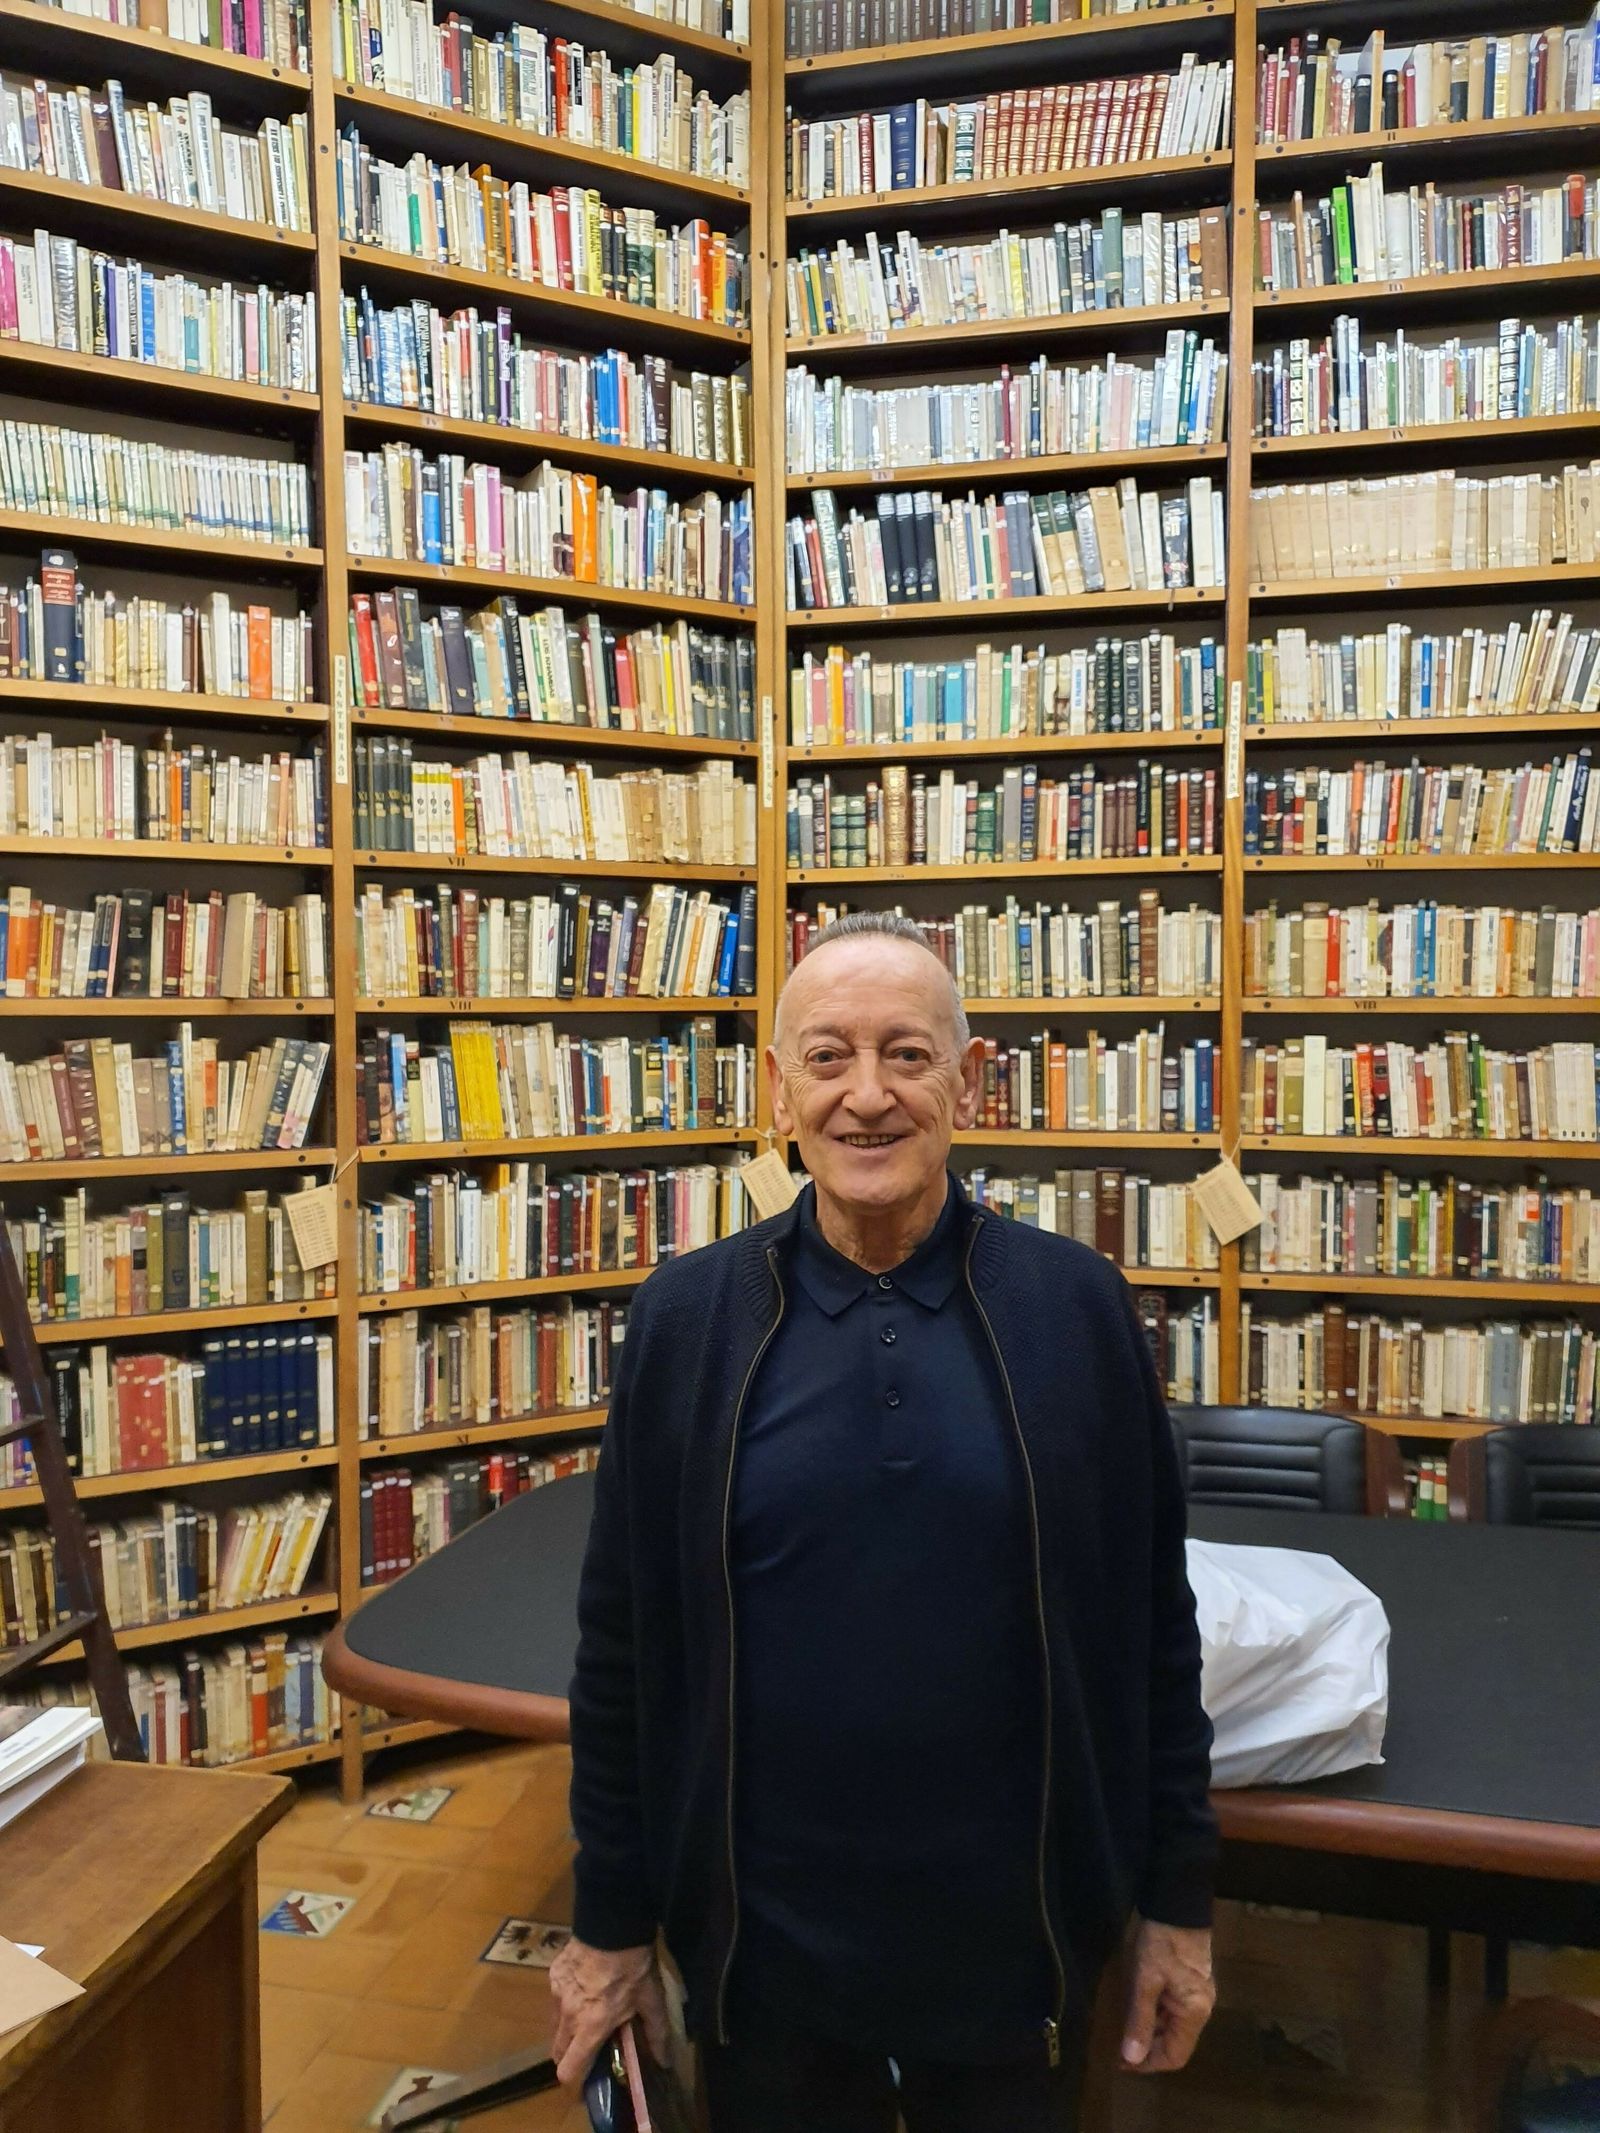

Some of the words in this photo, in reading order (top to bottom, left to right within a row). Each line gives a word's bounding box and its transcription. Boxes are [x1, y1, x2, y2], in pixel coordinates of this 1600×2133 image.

[447, 856, 465, 867] VII
[1366, 858, 1384, 868] VII
[449, 1000, 472, 1010] VIII
[1354, 1000, 1377, 1009] VIII
